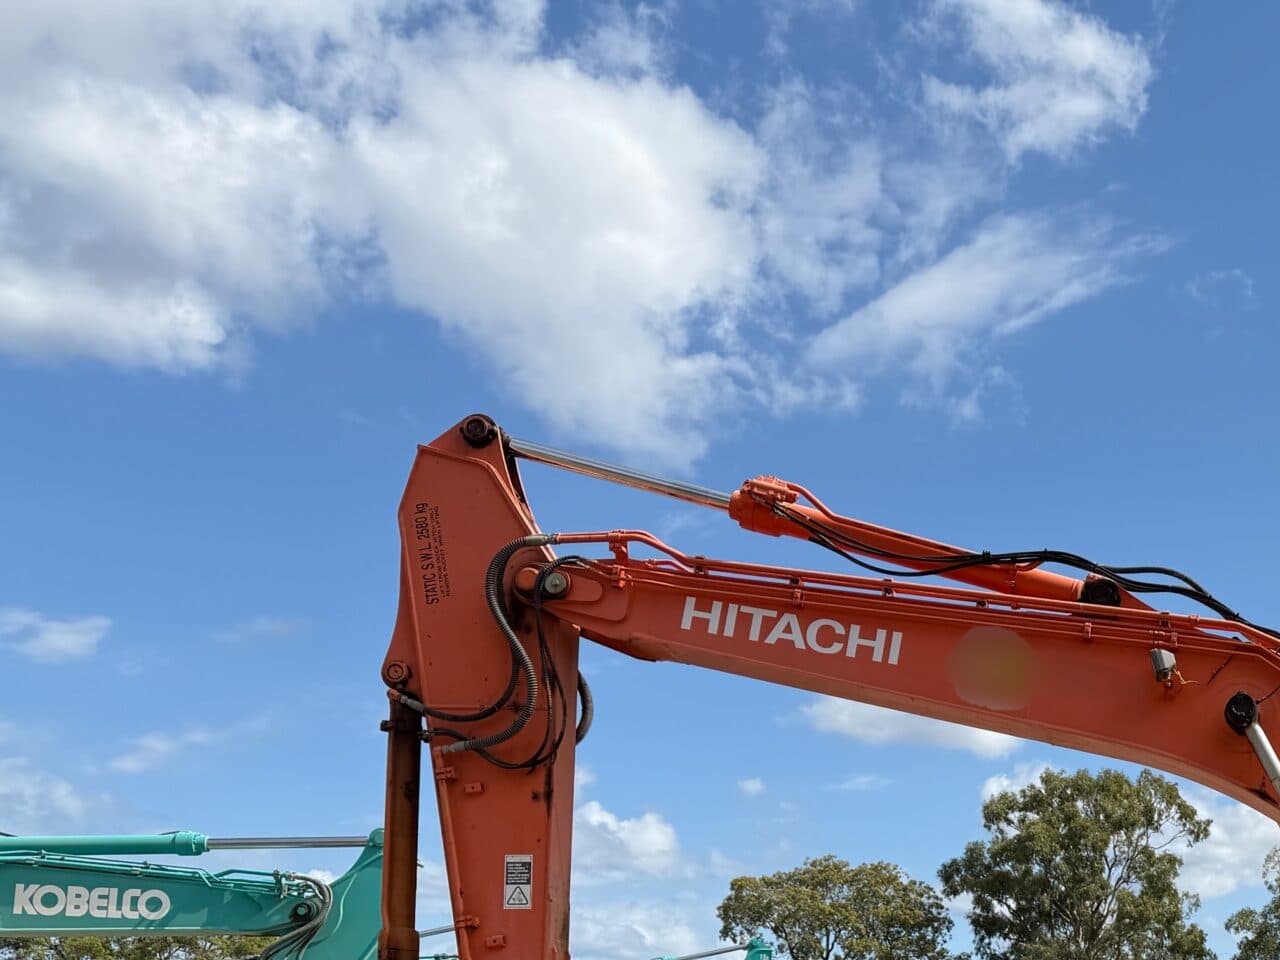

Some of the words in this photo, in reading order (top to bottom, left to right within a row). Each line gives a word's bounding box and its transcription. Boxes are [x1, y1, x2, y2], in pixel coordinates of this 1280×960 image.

[415, 503, 428, 514] kg
[415, 517, 430, 540] 2580
[423, 573, 439, 605] STATIC
[680, 596, 903, 665] HITACHI
[13, 883, 171, 920] KOBELCO
